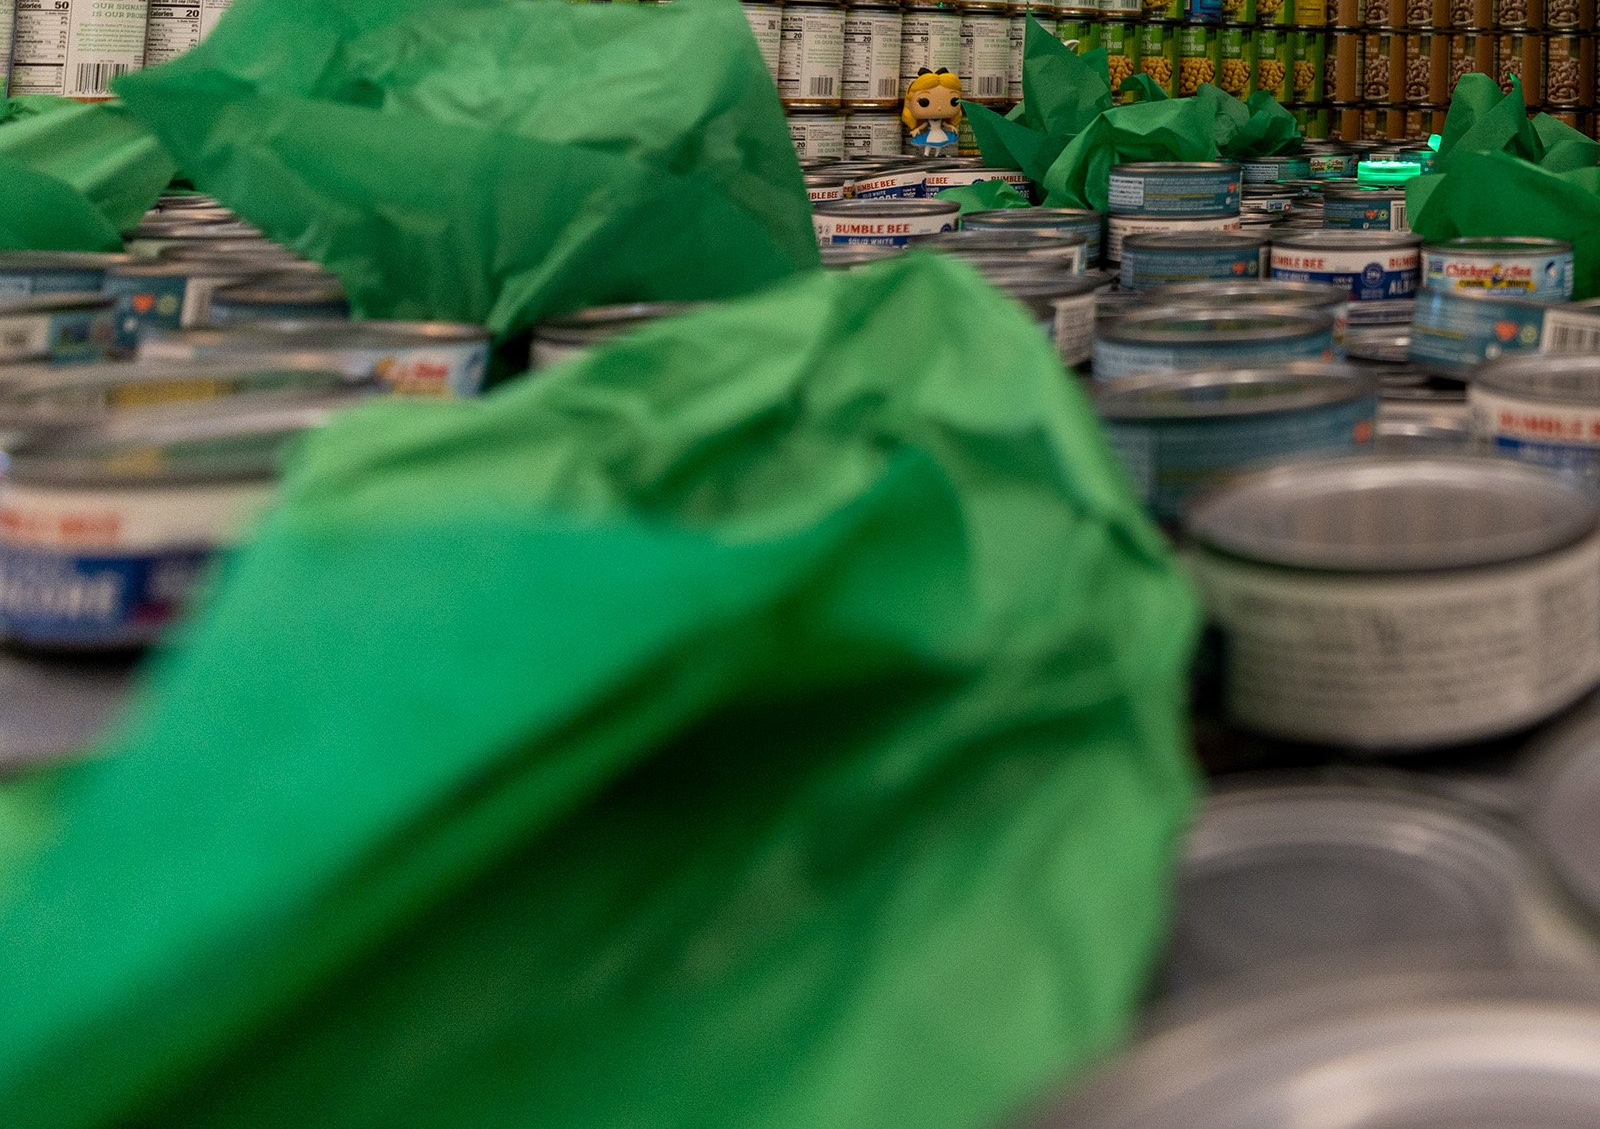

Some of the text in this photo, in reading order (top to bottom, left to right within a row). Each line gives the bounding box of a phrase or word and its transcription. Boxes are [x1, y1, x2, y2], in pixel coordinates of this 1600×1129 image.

[19, 1, 69, 10] Calories 50
[105, 11, 125, 19] OUR
[186, 9, 200, 18] 20
[880, 179, 896, 187] BEE
[827, 190, 839, 199] BEE
[835, 223, 911, 235] BUMBLE BEE
[848, 238, 894, 246] SOLID WHITE
